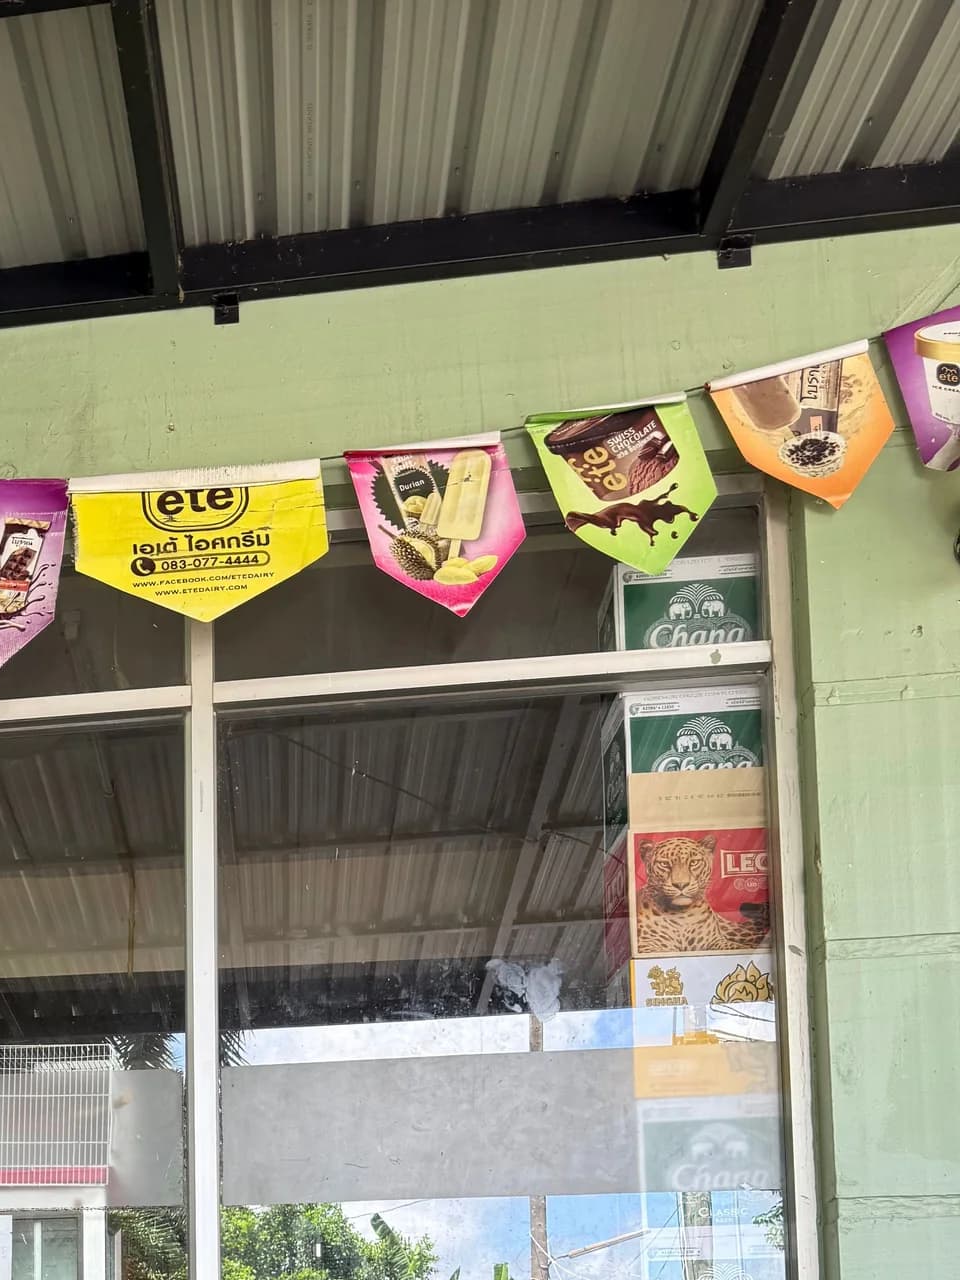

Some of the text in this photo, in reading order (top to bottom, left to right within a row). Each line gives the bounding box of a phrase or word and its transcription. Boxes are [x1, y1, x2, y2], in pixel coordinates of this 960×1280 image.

[607, 427, 636, 448] SWISS
[611, 420, 657, 454] CHOCOLATE
[398, 479, 425, 492] Durian
[156, 488, 234, 516] ete
[184, 531, 271, 552] ไอศกรีม
[161, 554, 259, 571] 083-077-4444
[132, 572, 275, 588] WWW.FACEBOOK.COM/ETEDAIRY
[155, 584, 248, 597] WWW.ETEDAIRY.COM
